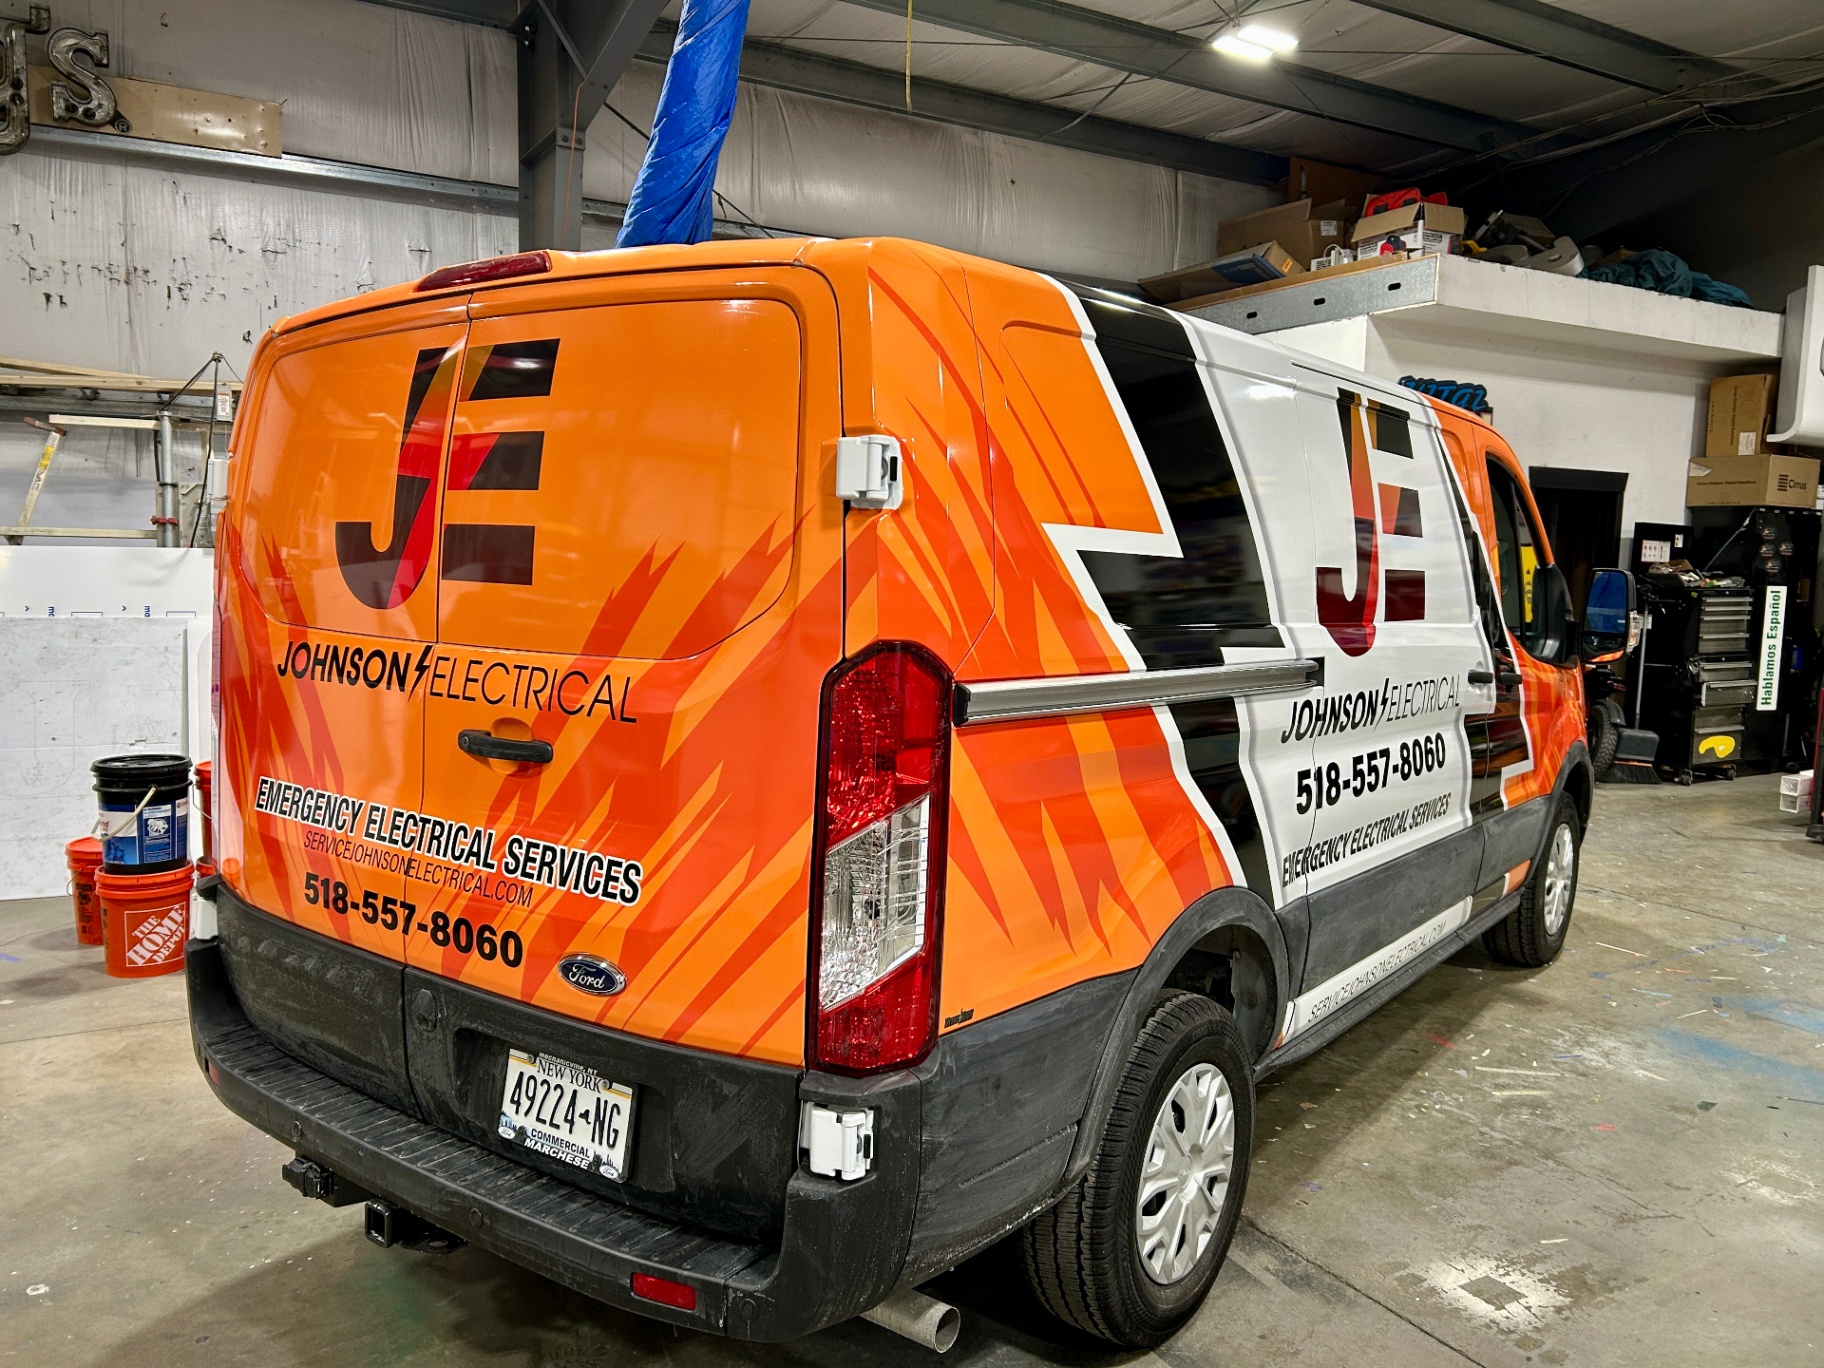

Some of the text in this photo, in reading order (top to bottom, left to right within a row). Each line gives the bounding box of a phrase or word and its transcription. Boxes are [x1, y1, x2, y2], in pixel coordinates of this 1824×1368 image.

[1788, 479, 1807, 490] Cirrus
[1767, 590, 1782, 639] Español
[277, 641, 637, 723] JOHNSON ELECTRICAL
[1761, 644, 1777, 706] Hablamos
[1280, 675, 1460, 744] JOHNSON ELECTRICAL
[1296, 732, 1446, 815] 518-557-8060
[254, 775, 643, 906] EMERGENCY ELECTRICAL SERVICES
[303, 830, 534, 908] SERVICEJOHNSONELECTRICAL.COM
[1282, 792, 1452, 888] EMERGENCY ELECTRICAL SERVICES
[127, 904, 186, 966] HOME
[131, 915, 160, 939] THE
[151, 924, 186, 964] DEPOT
[304, 872, 523, 968] 518-557-8060
[567, 962, 605, 990] Ford
[537, 1058, 602, 1094] NEW YORK
[509, 1071, 621, 1151] 49224 NG
[524, 1138, 590, 1170] MARCHESE
[530, 1128, 590, 1159] COMMERCIAL
